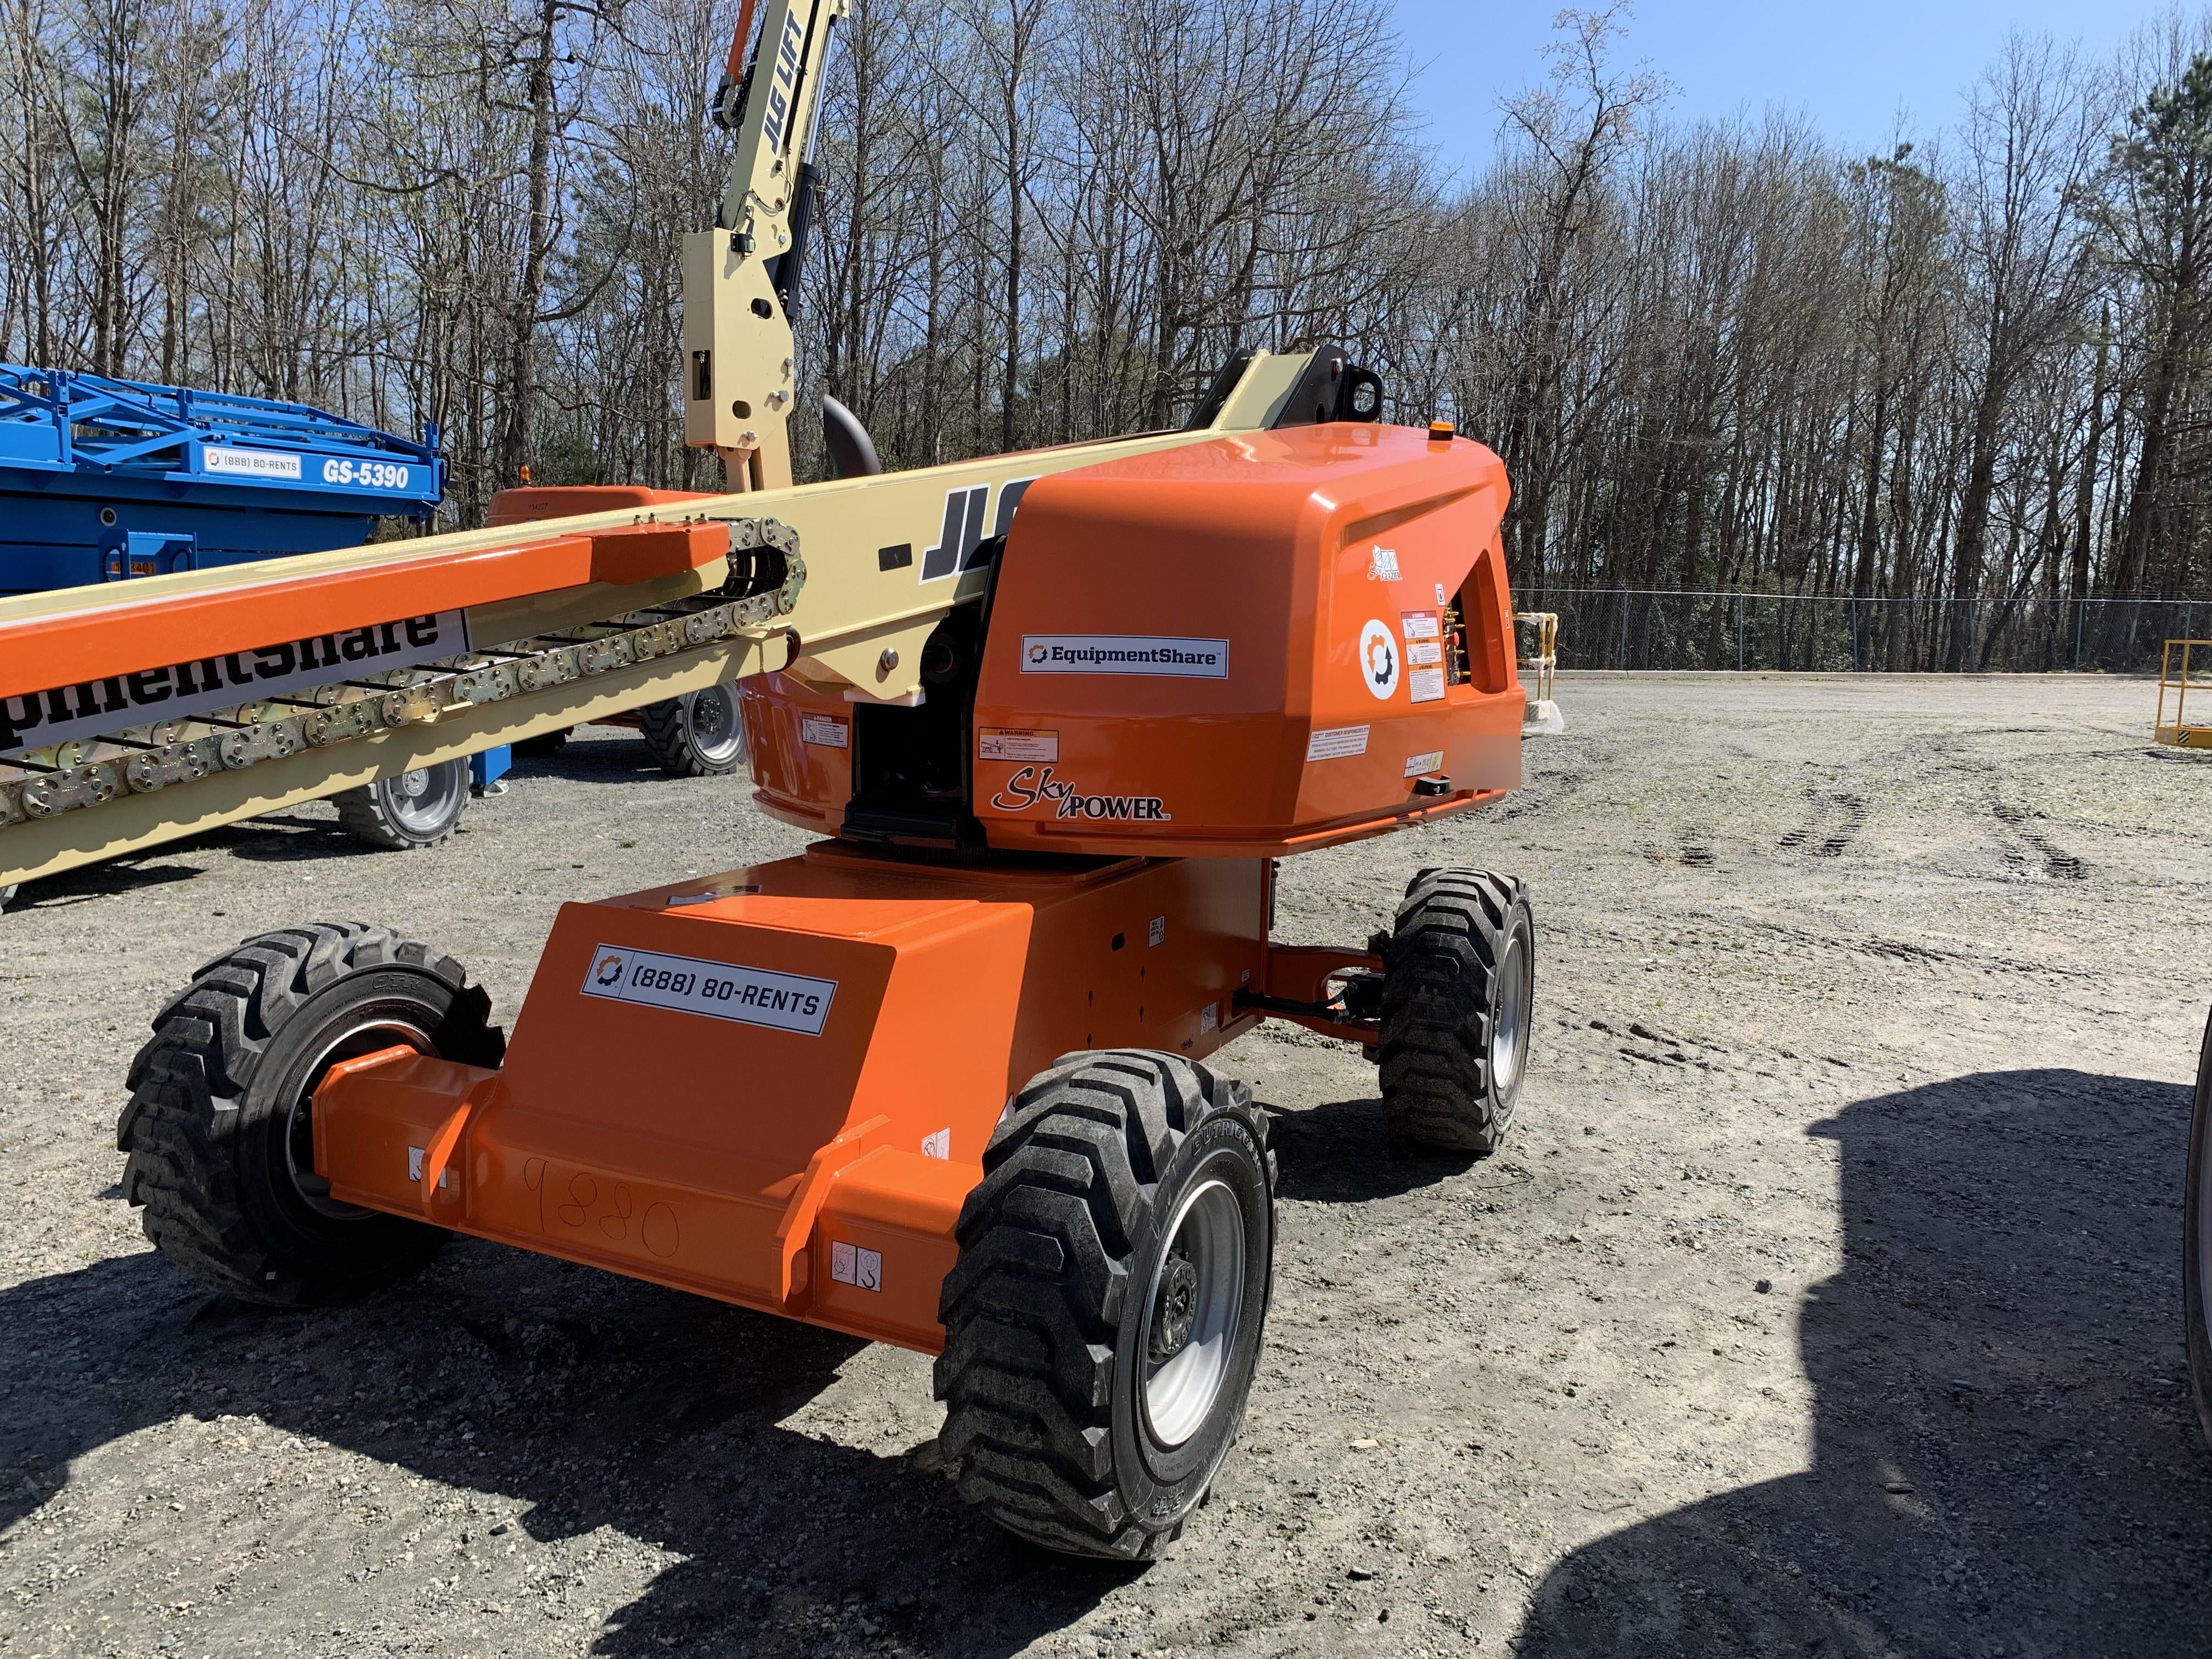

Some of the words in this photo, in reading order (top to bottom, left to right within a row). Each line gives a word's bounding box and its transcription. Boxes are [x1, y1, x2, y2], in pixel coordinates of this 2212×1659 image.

[764, 84, 787, 156] JLG
[776, 8, 802, 91] LIFT
[224, 455, 250, 467] (888)
[253, 459, 297, 471] 80-RENTS
[323, 459, 408, 489] GS-5390
[1051, 645, 1216, 665] EquipmentShare
[992, 767, 1074, 818] Sky
[1070, 795, 1164, 820] POWER
[373, 973, 421, 990] OTR
[631, 965, 696, 996] (888)
[701, 979, 820, 1015] 80-RENTS
[524, 1157, 680, 1258] 9880
